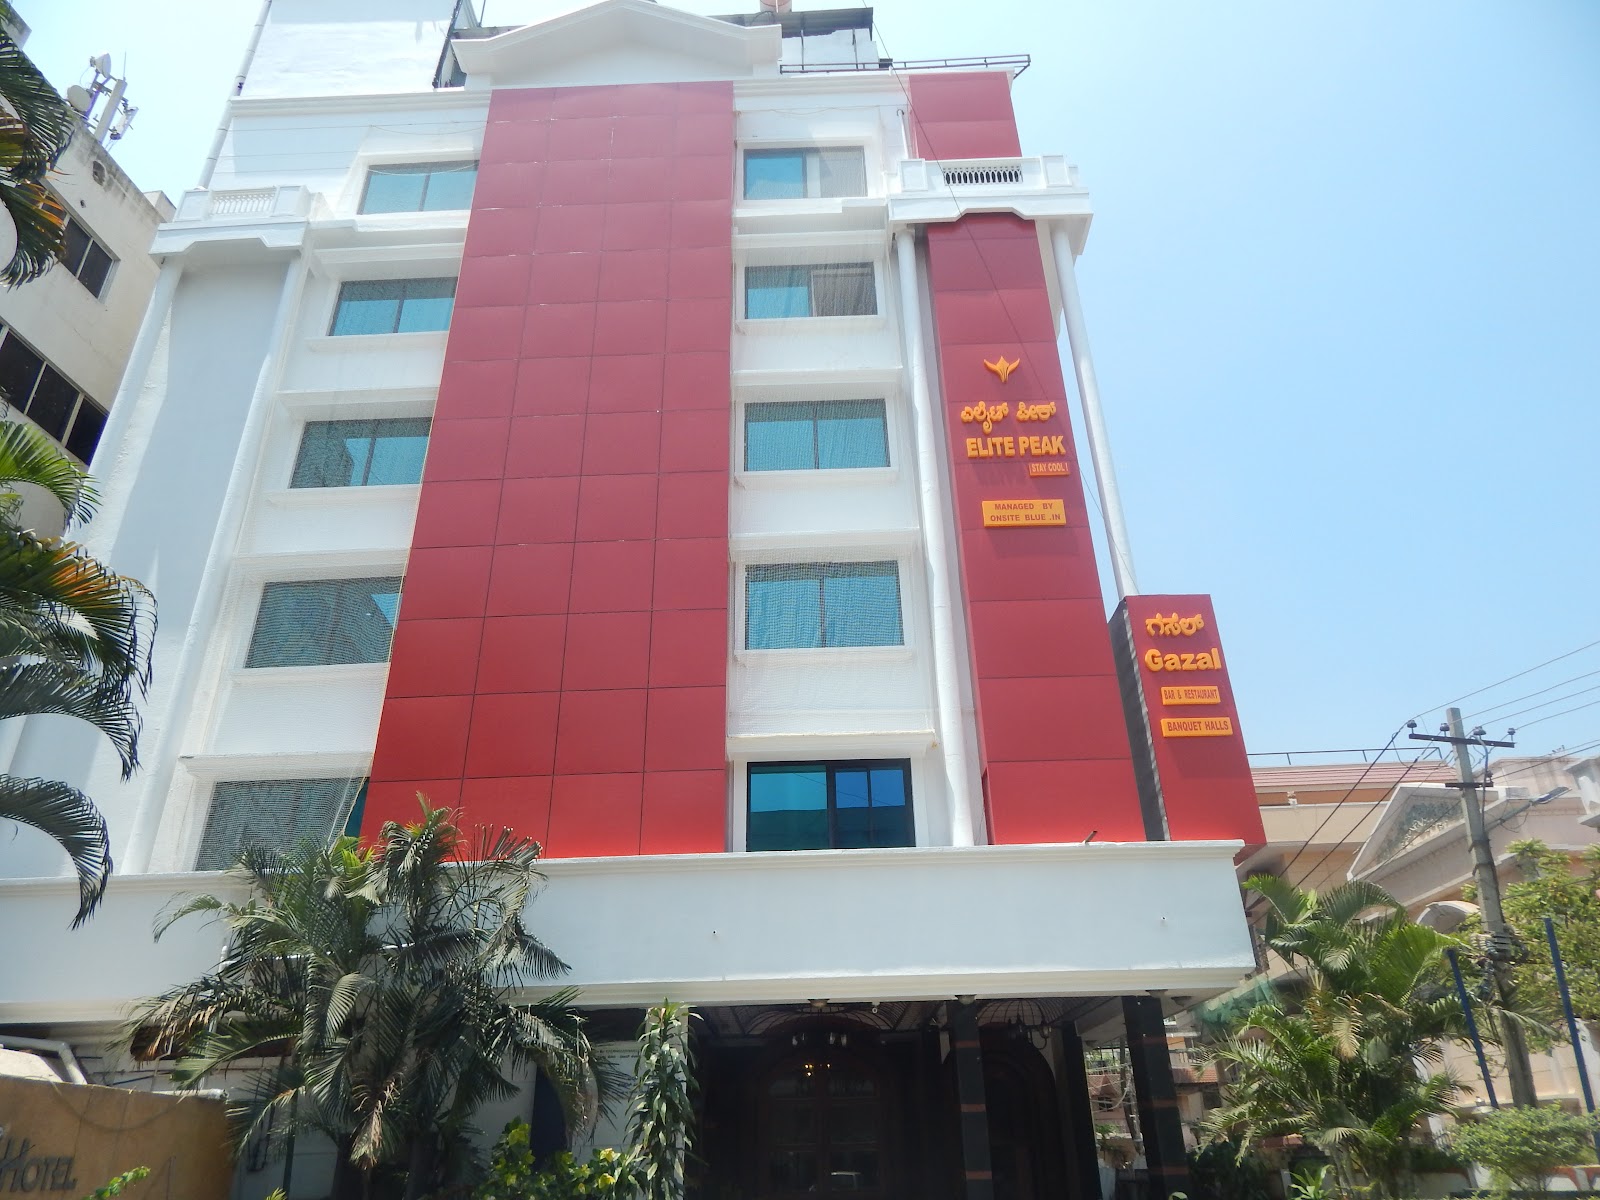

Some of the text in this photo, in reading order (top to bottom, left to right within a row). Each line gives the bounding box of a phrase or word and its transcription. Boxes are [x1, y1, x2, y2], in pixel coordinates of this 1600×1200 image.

[966, 435, 1066, 457] ELITE PEAK
[1032, 463, 1047, 472] STAY
[990, 514, 1020, 522] ONSITE
[1144, 648, 1222, 671] Gazal
[1163, 690, 1175, 700] BAR
[1184, 689, 1218, 700] RESTAURANT
[1167, 720, 1229, 732] BANQUET HALLS
